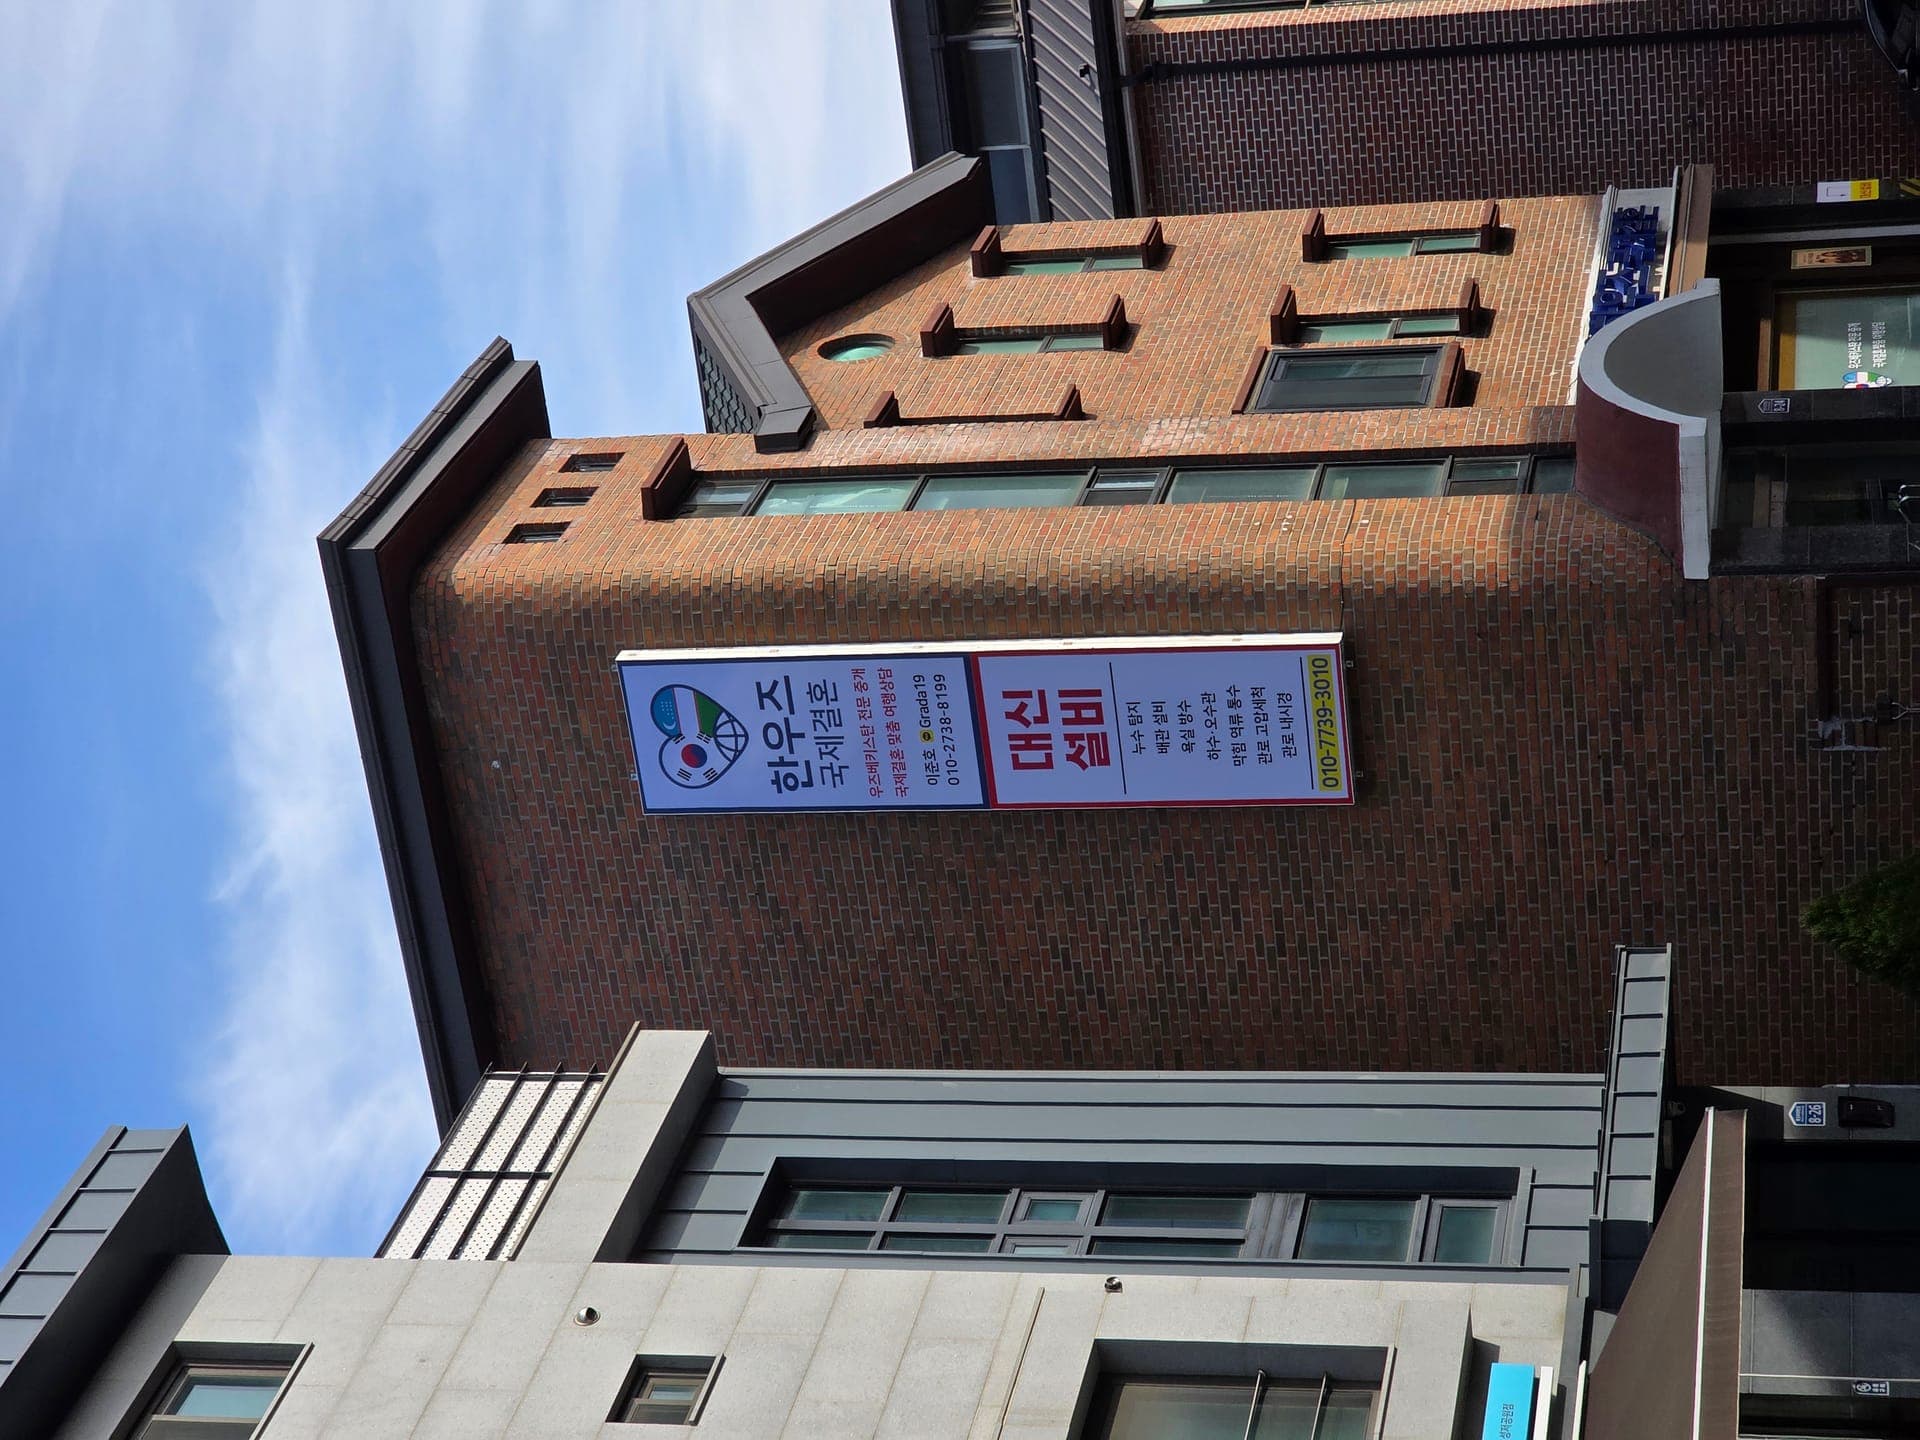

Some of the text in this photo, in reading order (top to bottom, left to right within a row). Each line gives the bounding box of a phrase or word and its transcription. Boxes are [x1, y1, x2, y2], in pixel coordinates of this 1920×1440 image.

[877, 667, 897, 716] 여행상담
[913, 675, 940, 785] 이준호 Grada19
[933, 675, 959, 785] 010-2738-8199
[1002, 689, 1054, 770] 대신
[1058, 689, 1110, 771] 설비
[1126, 702, 1146, 754] 누수 탐지
[1151, 701, 1170, 753] 배관 설비
[1177, 700, 1195, 753] 욕실 방수
[1226, 684, 1247, 766] 막힘 역류 통수
[1251, 687, 1272, 765] 관로 고압세척
[1277, 692, 1297, 758] 관로 내시경
[1312, 658, 1338, 787] 010-7739-3010
[756, 675, 813, 794] 한우즈
[806, 679, 849, 788] 국제결혼
[851, 668, 884, 798] 우즈베키스탄 전문 중개
[1808, 1104, 1822, 1123] 8-26
